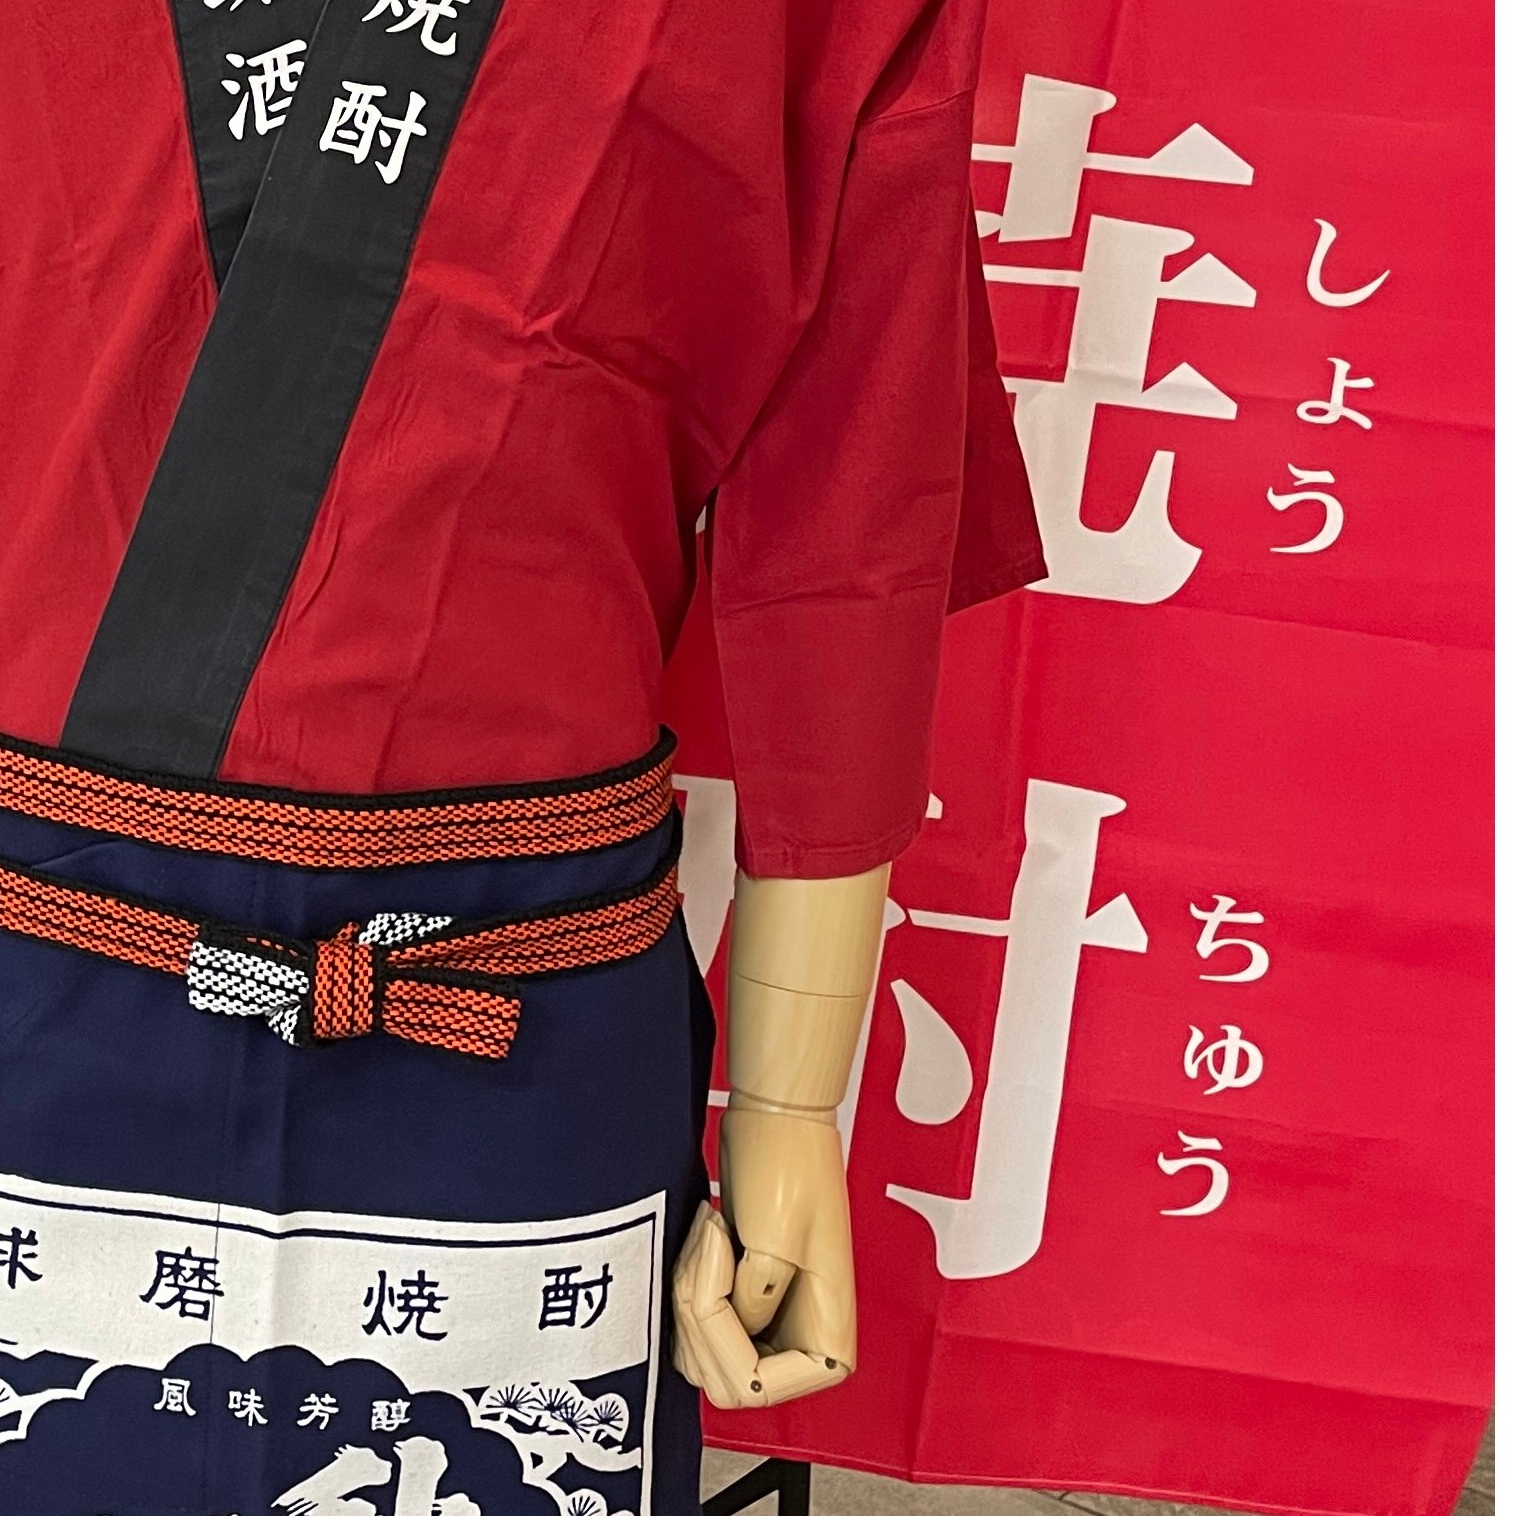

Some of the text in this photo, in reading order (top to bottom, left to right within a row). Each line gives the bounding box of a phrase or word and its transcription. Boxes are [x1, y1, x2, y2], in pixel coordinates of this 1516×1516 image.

[1267, 217, 1391, 555] しょう
[1156, 894, 1272, 1218] ちゅう
[153, 1378, 413, 1433] 風味芳醇
